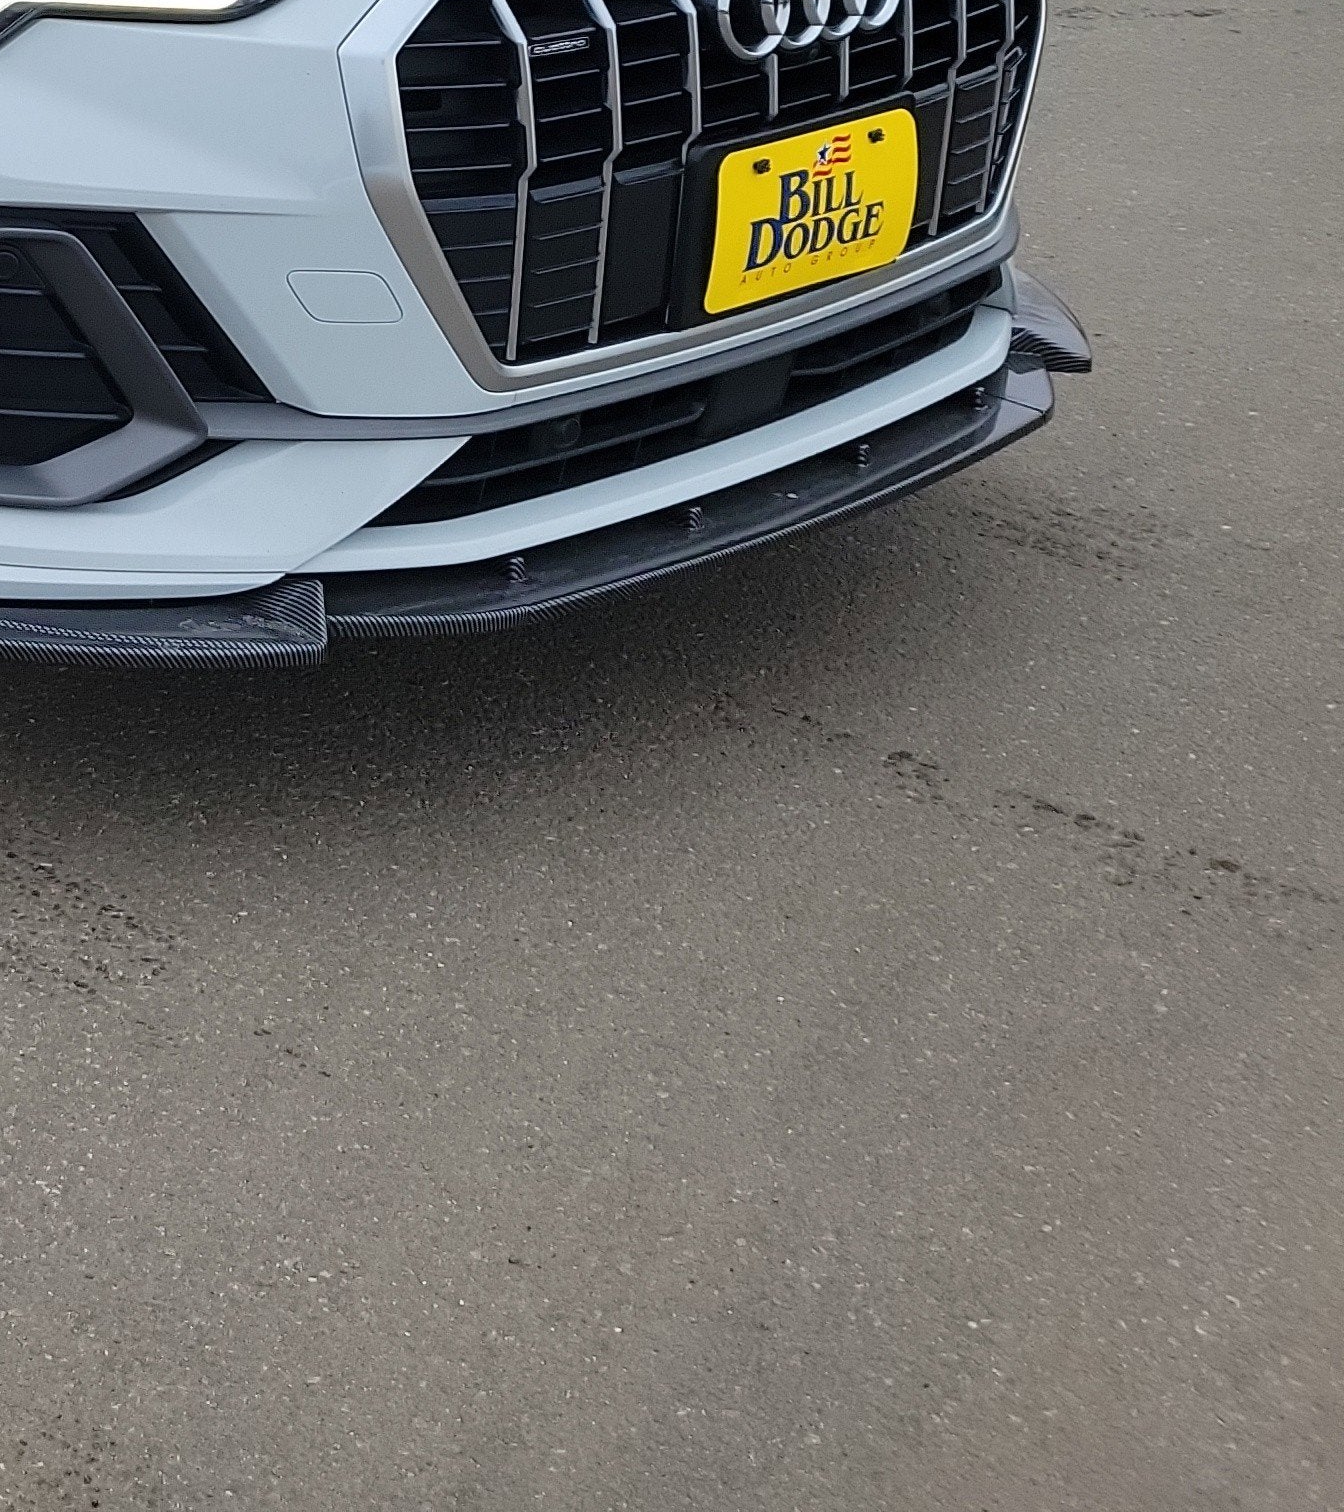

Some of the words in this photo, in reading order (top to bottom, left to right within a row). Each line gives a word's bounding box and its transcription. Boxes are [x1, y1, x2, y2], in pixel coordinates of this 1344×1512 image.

[778, 168, 864, 225] BILL
[739, 262, 792, 286] AUTO
[810, 238, 876, 266] GROUP
[742, 201, 885, 273] DODGE
